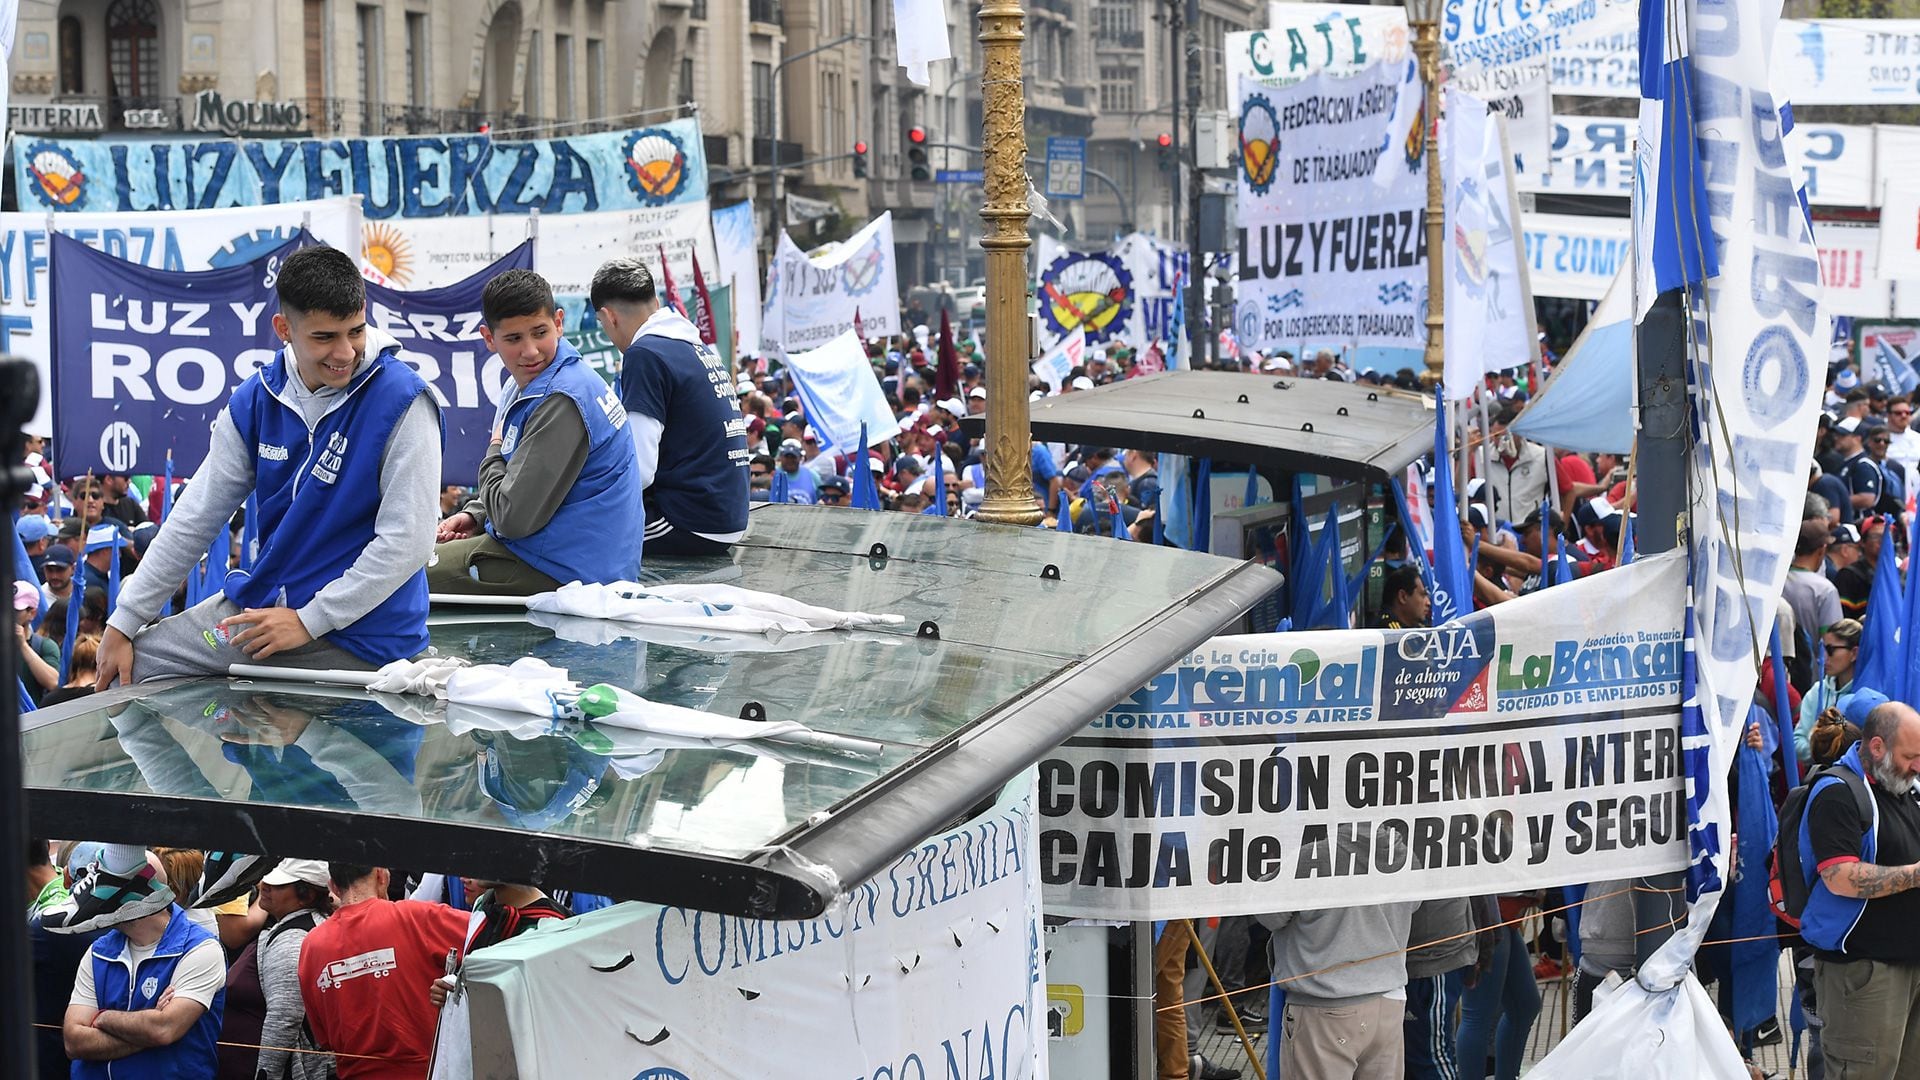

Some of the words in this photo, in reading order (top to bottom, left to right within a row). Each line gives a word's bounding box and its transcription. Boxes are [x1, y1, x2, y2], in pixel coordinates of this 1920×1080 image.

[125, 110, 168, 128] DEL
[1283, 94, 1355, 131] FEDERACION
[1293, 156, 1310, 184] DE
[1238, 223, 1303, 281] LUZ
[91, 293, 210, 336] LUZ
[230, 302, 266, 336] Y
[1264, 318, 1284, 343] POR
[1286, 317, 1300, 338] LOS
[1302, 313, 1340, 338] DERECHOS
[1358, 313, 1415, 338] TRABAJADOR
[1372, 512, 1379, 523] 6
[1370, 566, 1383, 577] 50
[1397, 629, 1481, 669] CAJA
[1582, 633, 1635, 650] Asociación
[1637, 627, 1681, 642] Bancaria
[1182, 652, 1205, 665] de
[1211, 650, 1232, 665] La
[1239, 649, 1279, 667] Caja
[1395, 667, 1413, 685] de
[1415, 665, 1461, 684] ahorro
[1392, 687, 1403, 705] y
[1405, 685, 1448, 705] seguro
[1497, 697, 1559, 713] SOCIEDAD
[1564, 692, 1583, 705] DE
[1588, 685, 1666, 703] EMPLEADOS
[1199, 709, 1299, 727] BUENOS
[1305, 706, 1373, 724] AIRES
[1038, 747, 1330, 819] COMISIÓN
[1345, 740, 1554, 810] GREMIAL
[1040, 829, 1193, 889] CAJA
[1207, 828, 1282, 886] de
[1294, 808, 1515, 880] AHORRO
[1526, 814, 1555, 866] y
